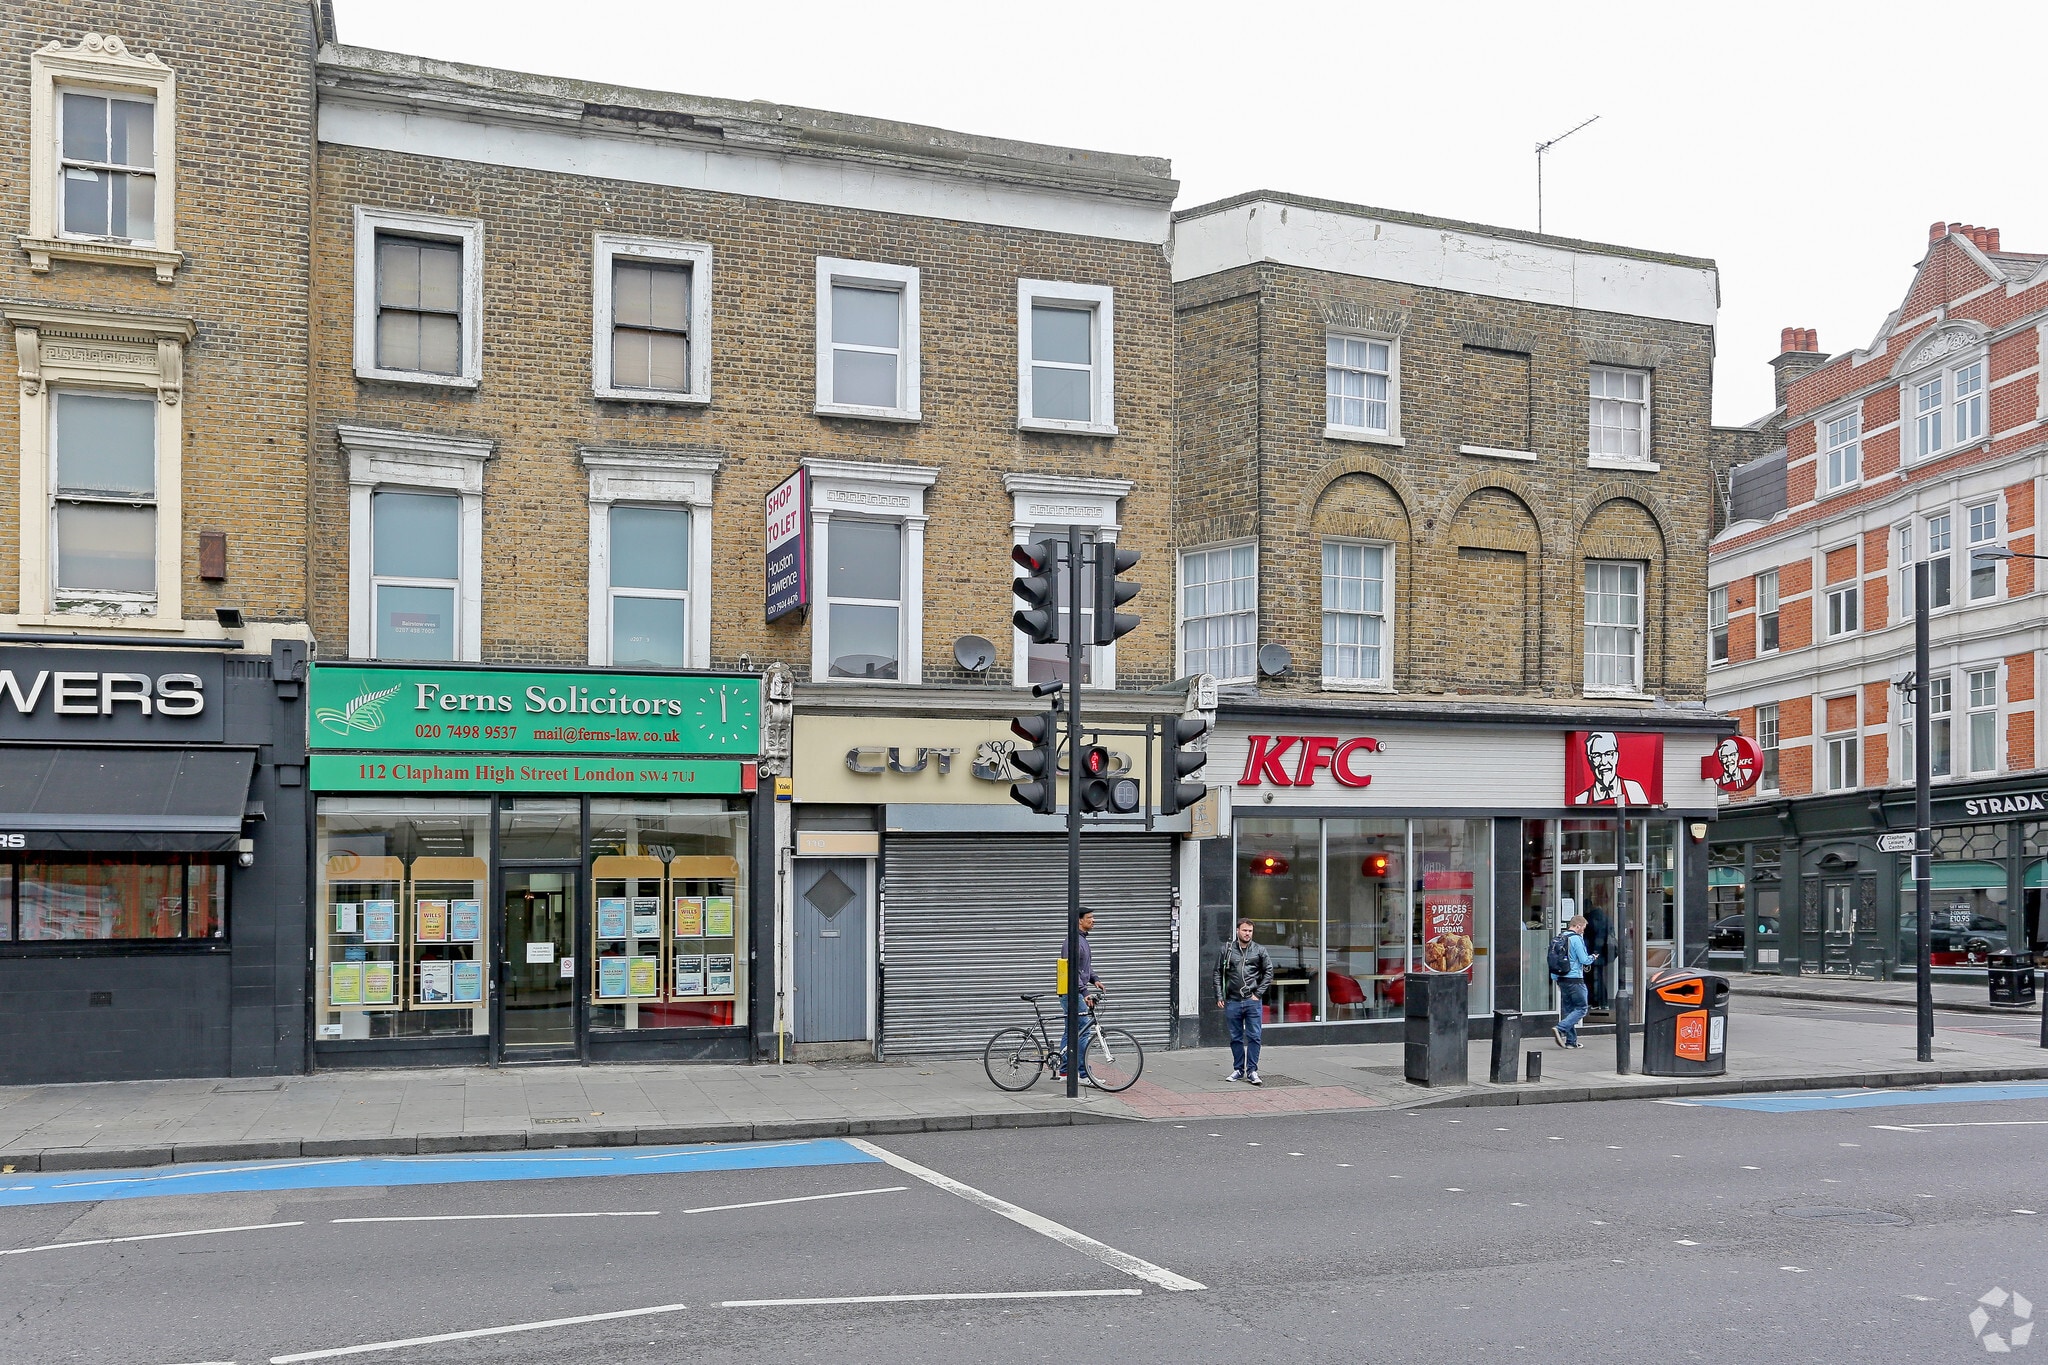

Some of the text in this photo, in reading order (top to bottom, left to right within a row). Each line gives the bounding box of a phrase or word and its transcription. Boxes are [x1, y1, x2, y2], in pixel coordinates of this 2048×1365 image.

[768, 485, 792, 517] SHOP
[768, 510, 797, 544] TO LET
[768, 553, 794, 578] Houston
[767, 571, 798, 597] Lawrence
[414, 683, 682, 717] Ferns Solicitors
[415, 724, 441, 738] 020
[447, 725, 480, 739] 7498
[484, 726, 517, 740] 9537
[845, 747, 960, 774] CUT
[1237, 735, 1377, 788] KFC
[1738, 757, 1753, 766] KFC
[359, 764, 695, 784] 112 Clapham High Street London SW4 7UJ
[1965, 794, 2046, 816] STRADA
[805, 839, 826, 848] 110
[1431, 904, 1468, 914] 9 PIECES
[1443, 913, 1465, 926] 5.99
[1950, 915, 1970, 923] £10.95
[1433, 925, 1464, 933] TUESDAYS
